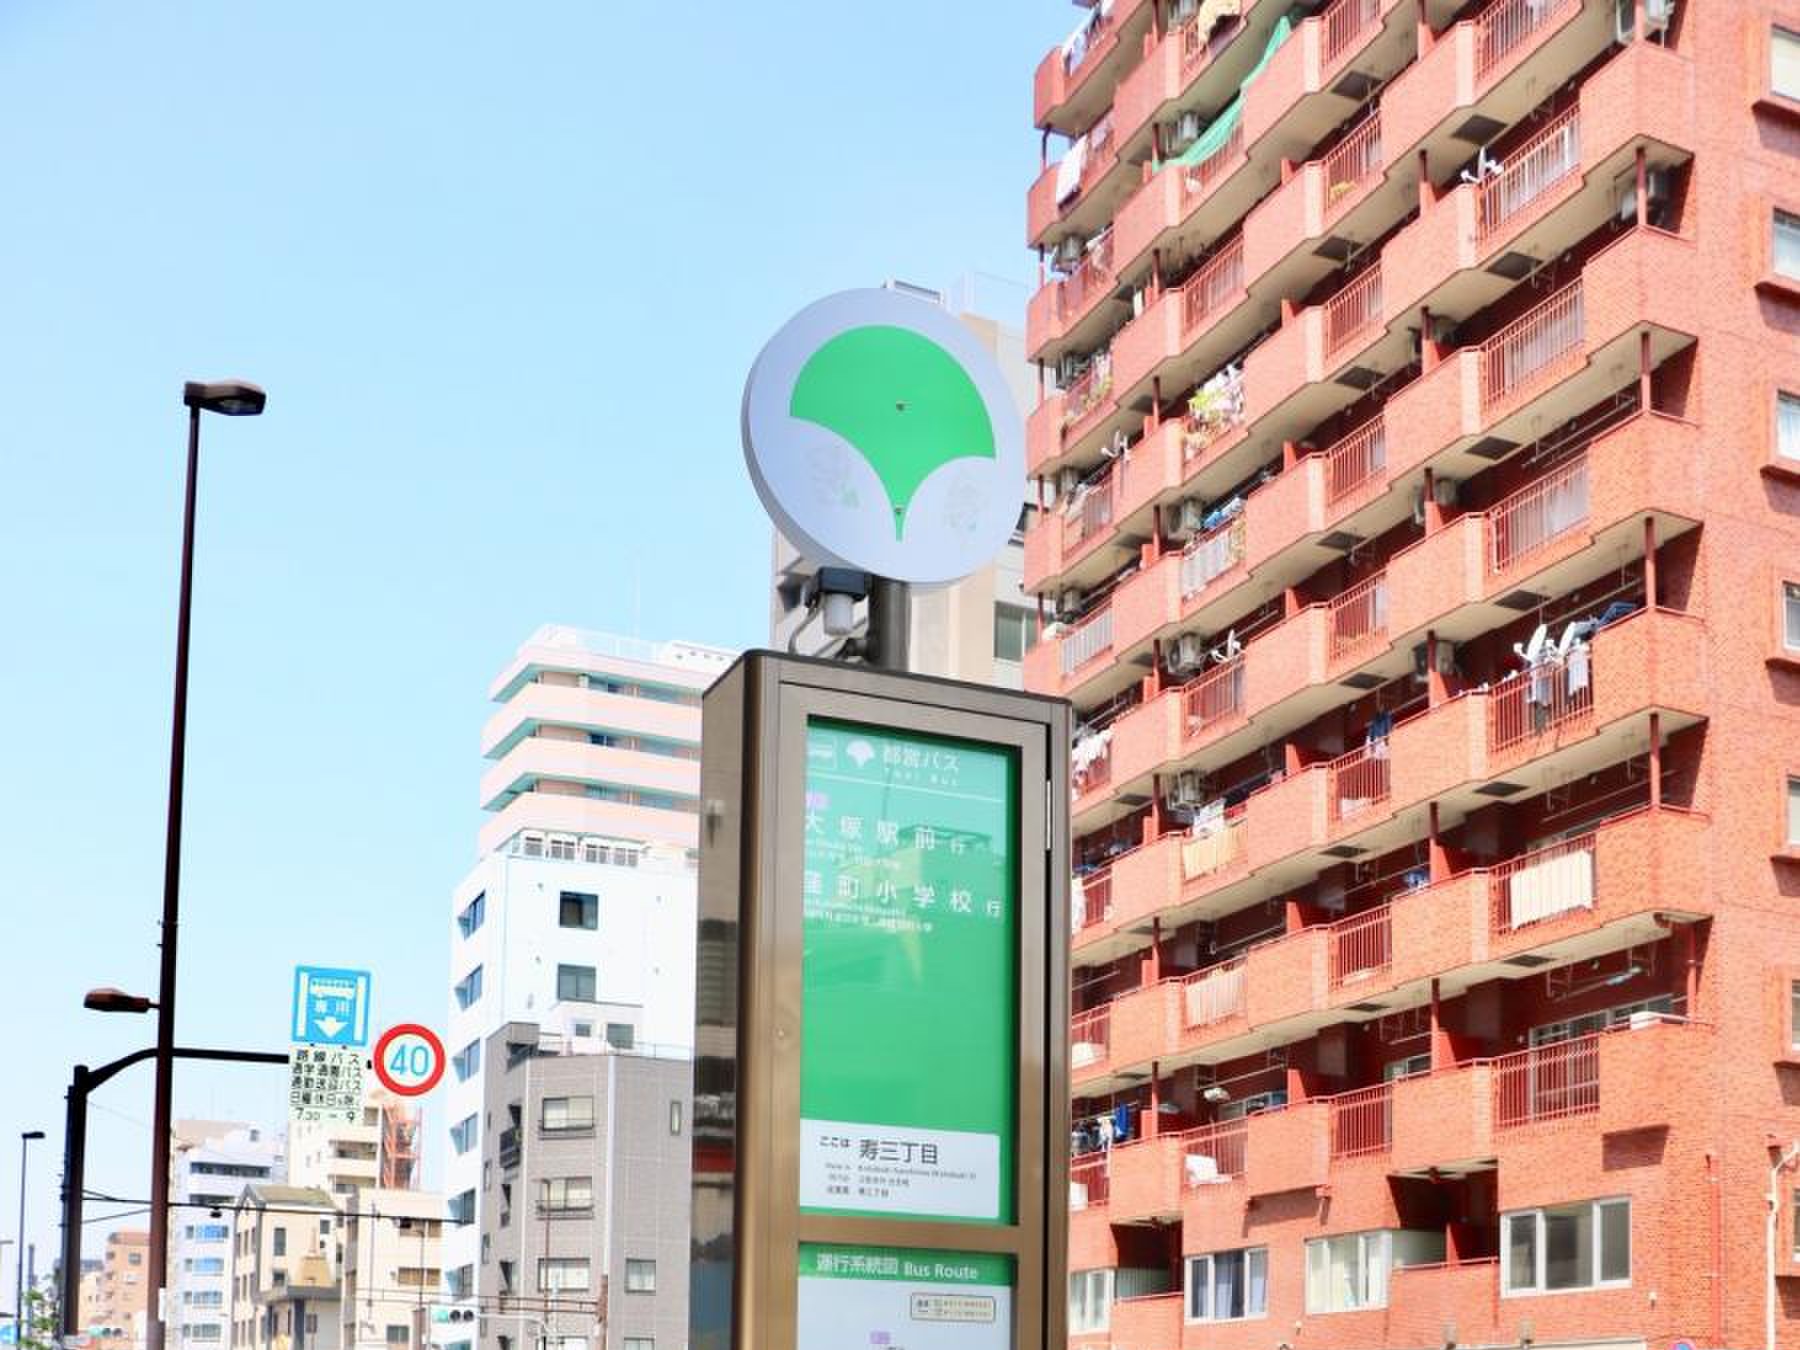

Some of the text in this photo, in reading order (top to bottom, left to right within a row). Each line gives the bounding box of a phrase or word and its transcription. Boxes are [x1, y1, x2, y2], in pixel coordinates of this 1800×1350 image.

[389, 1044, 430, 1077] 40
[819, 1135, 939, 1165] ここは 寿三丁目
[903, 1260, 931, 1277] Bus
[934, 1263, 979, 1280] Route
